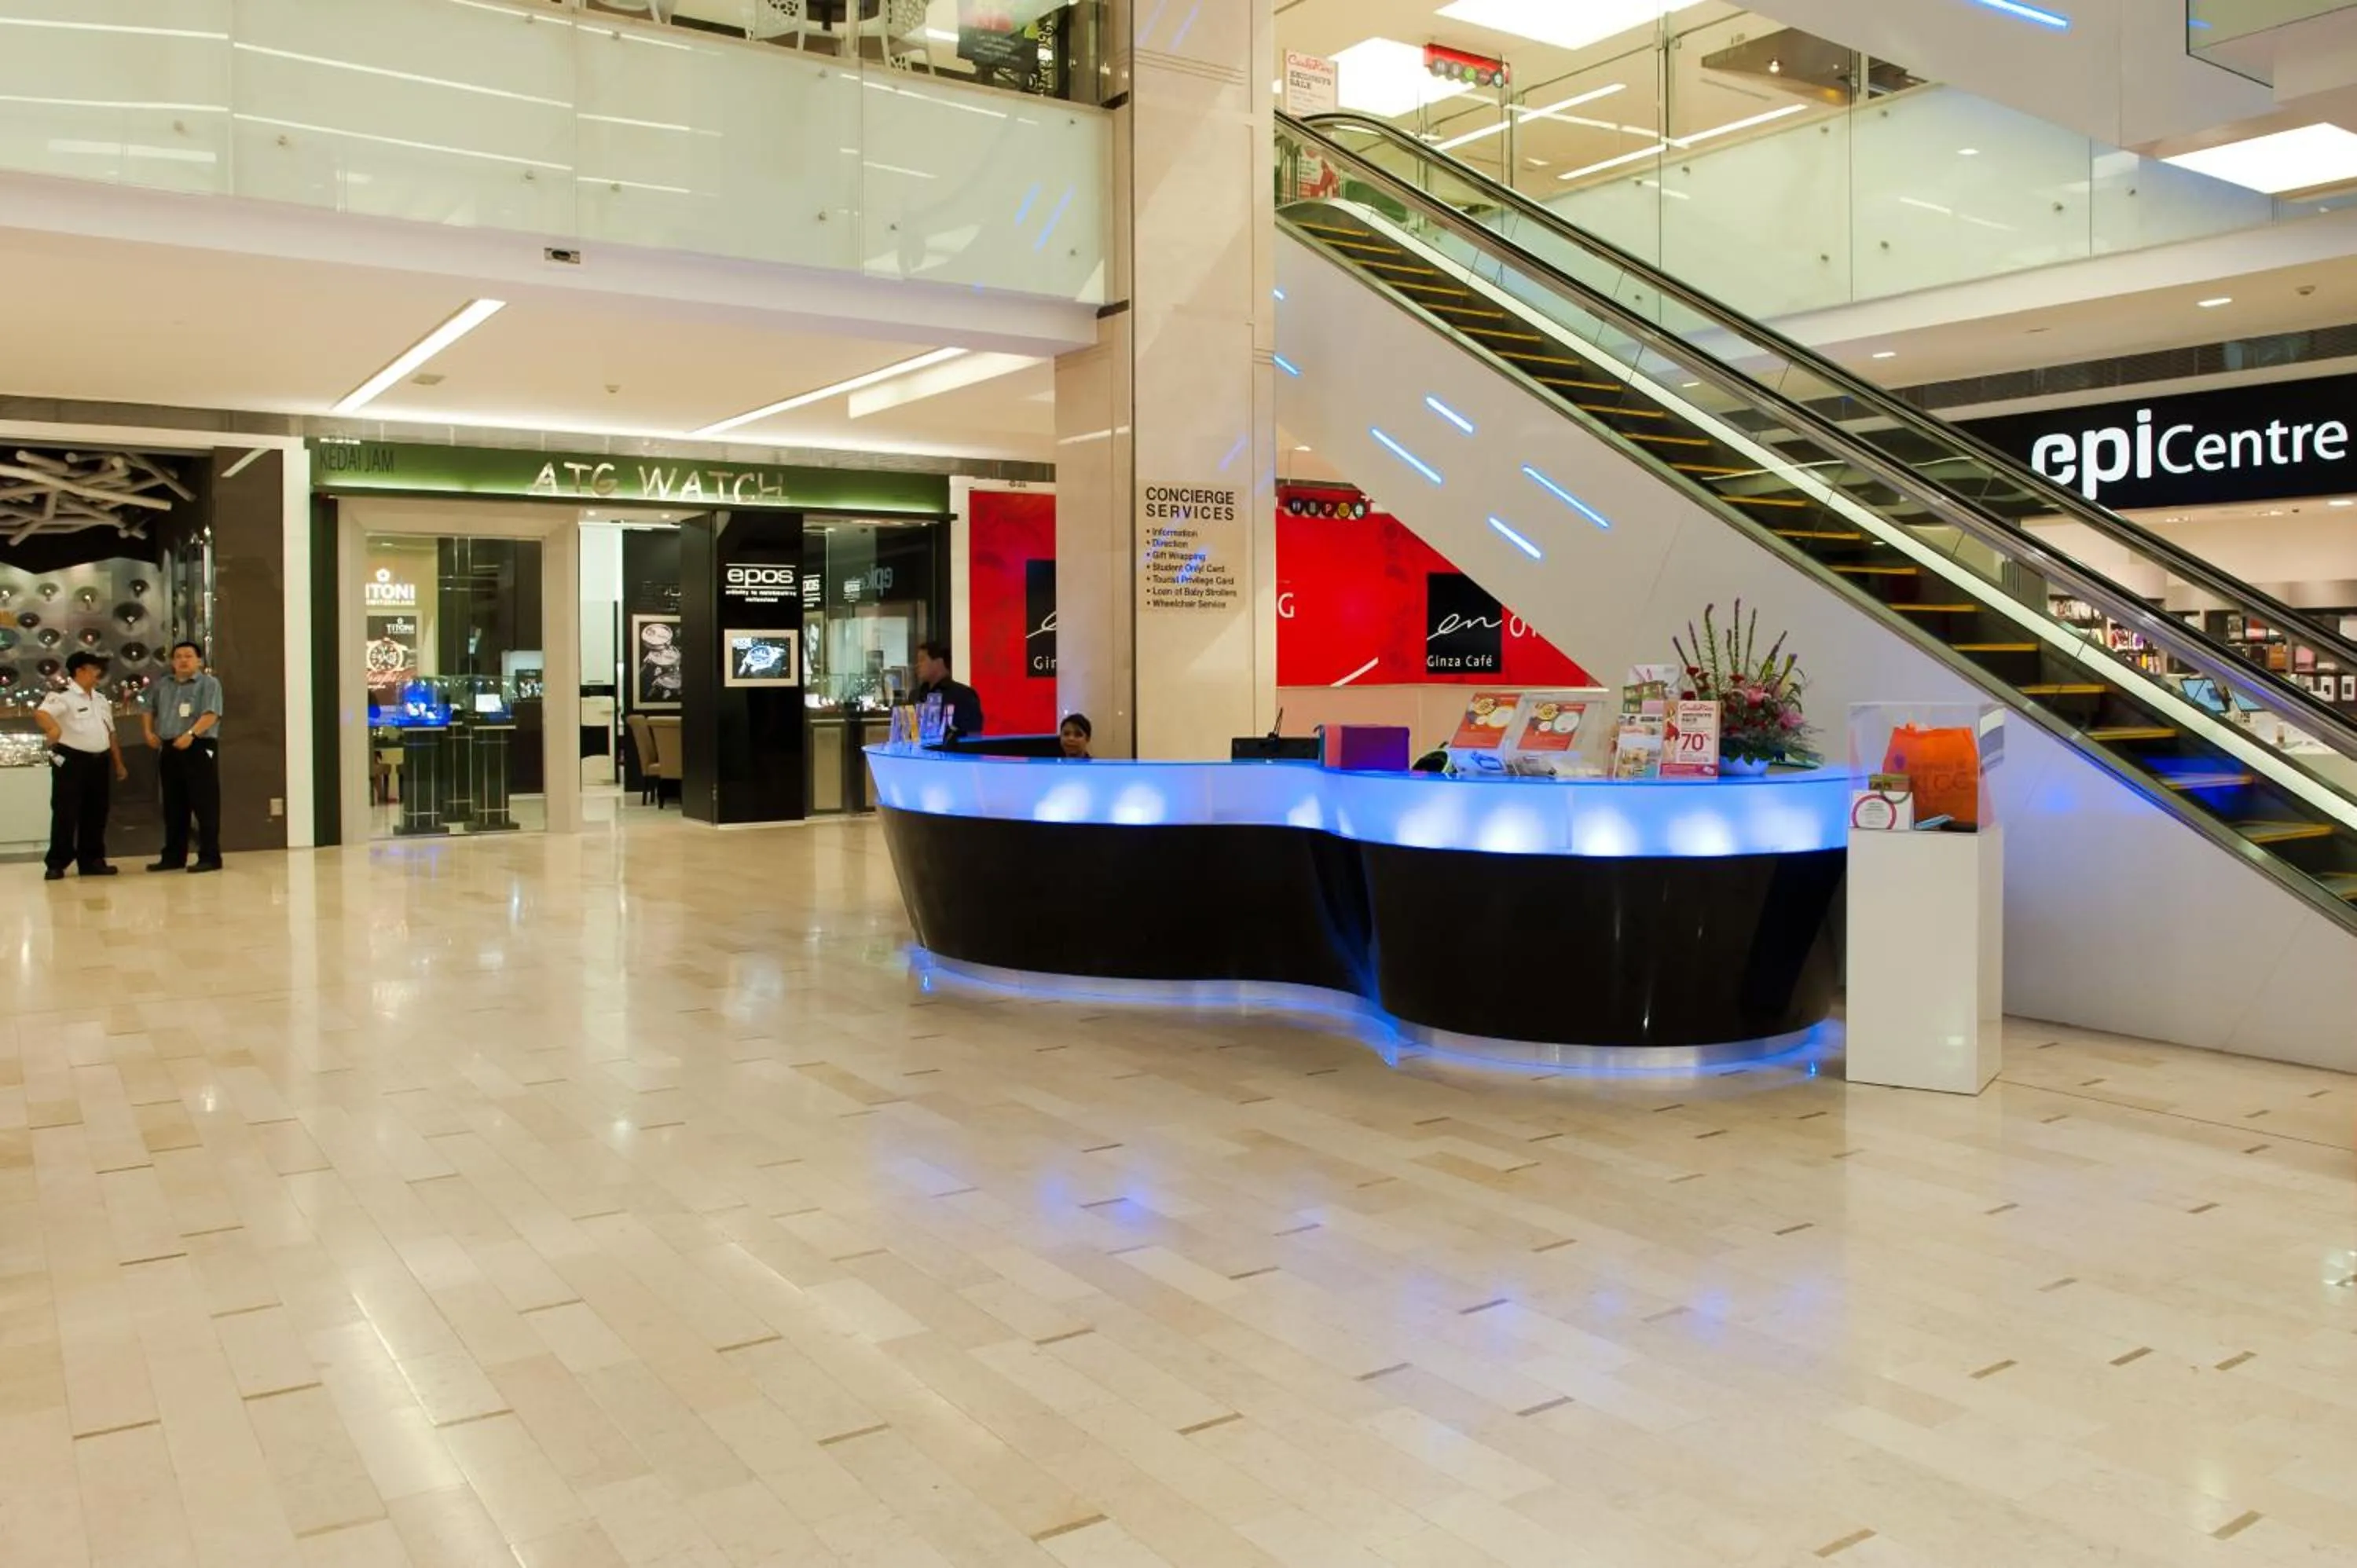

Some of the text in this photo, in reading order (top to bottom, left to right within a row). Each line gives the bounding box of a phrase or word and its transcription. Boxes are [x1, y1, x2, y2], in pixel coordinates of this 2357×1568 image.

[319, 445, 394, 474] KEDAI JAM
[2031, 408, 2348, 500] epiCentre
[637, 465, 785, 503] WATCH
[1146, 486, 1235, 505] CONCIERGE
[1146, 503, 1234, 521] SERVICES
[1152, 528, 1198, 537] Information
[1152, 538, 1189, 548] Direction
[1153, 551, 1206, 562] Gift Wrapping
[1153, 562, 1183, 572] Student
[1206, 564, 1225, 573] Card
[727, 568, 794, 588] epos
[1153, 573, 1234, 586] Tourist Privilege Card
[1153, 587, 1172, 595] Loan
[1174, 587, 1182, 595] of
[1184, 588, 1204, 597] Baby
[1152, 598, 1226, 608] Wheelchair Service
[1427, 654, 1493, 668] Ginza Café
